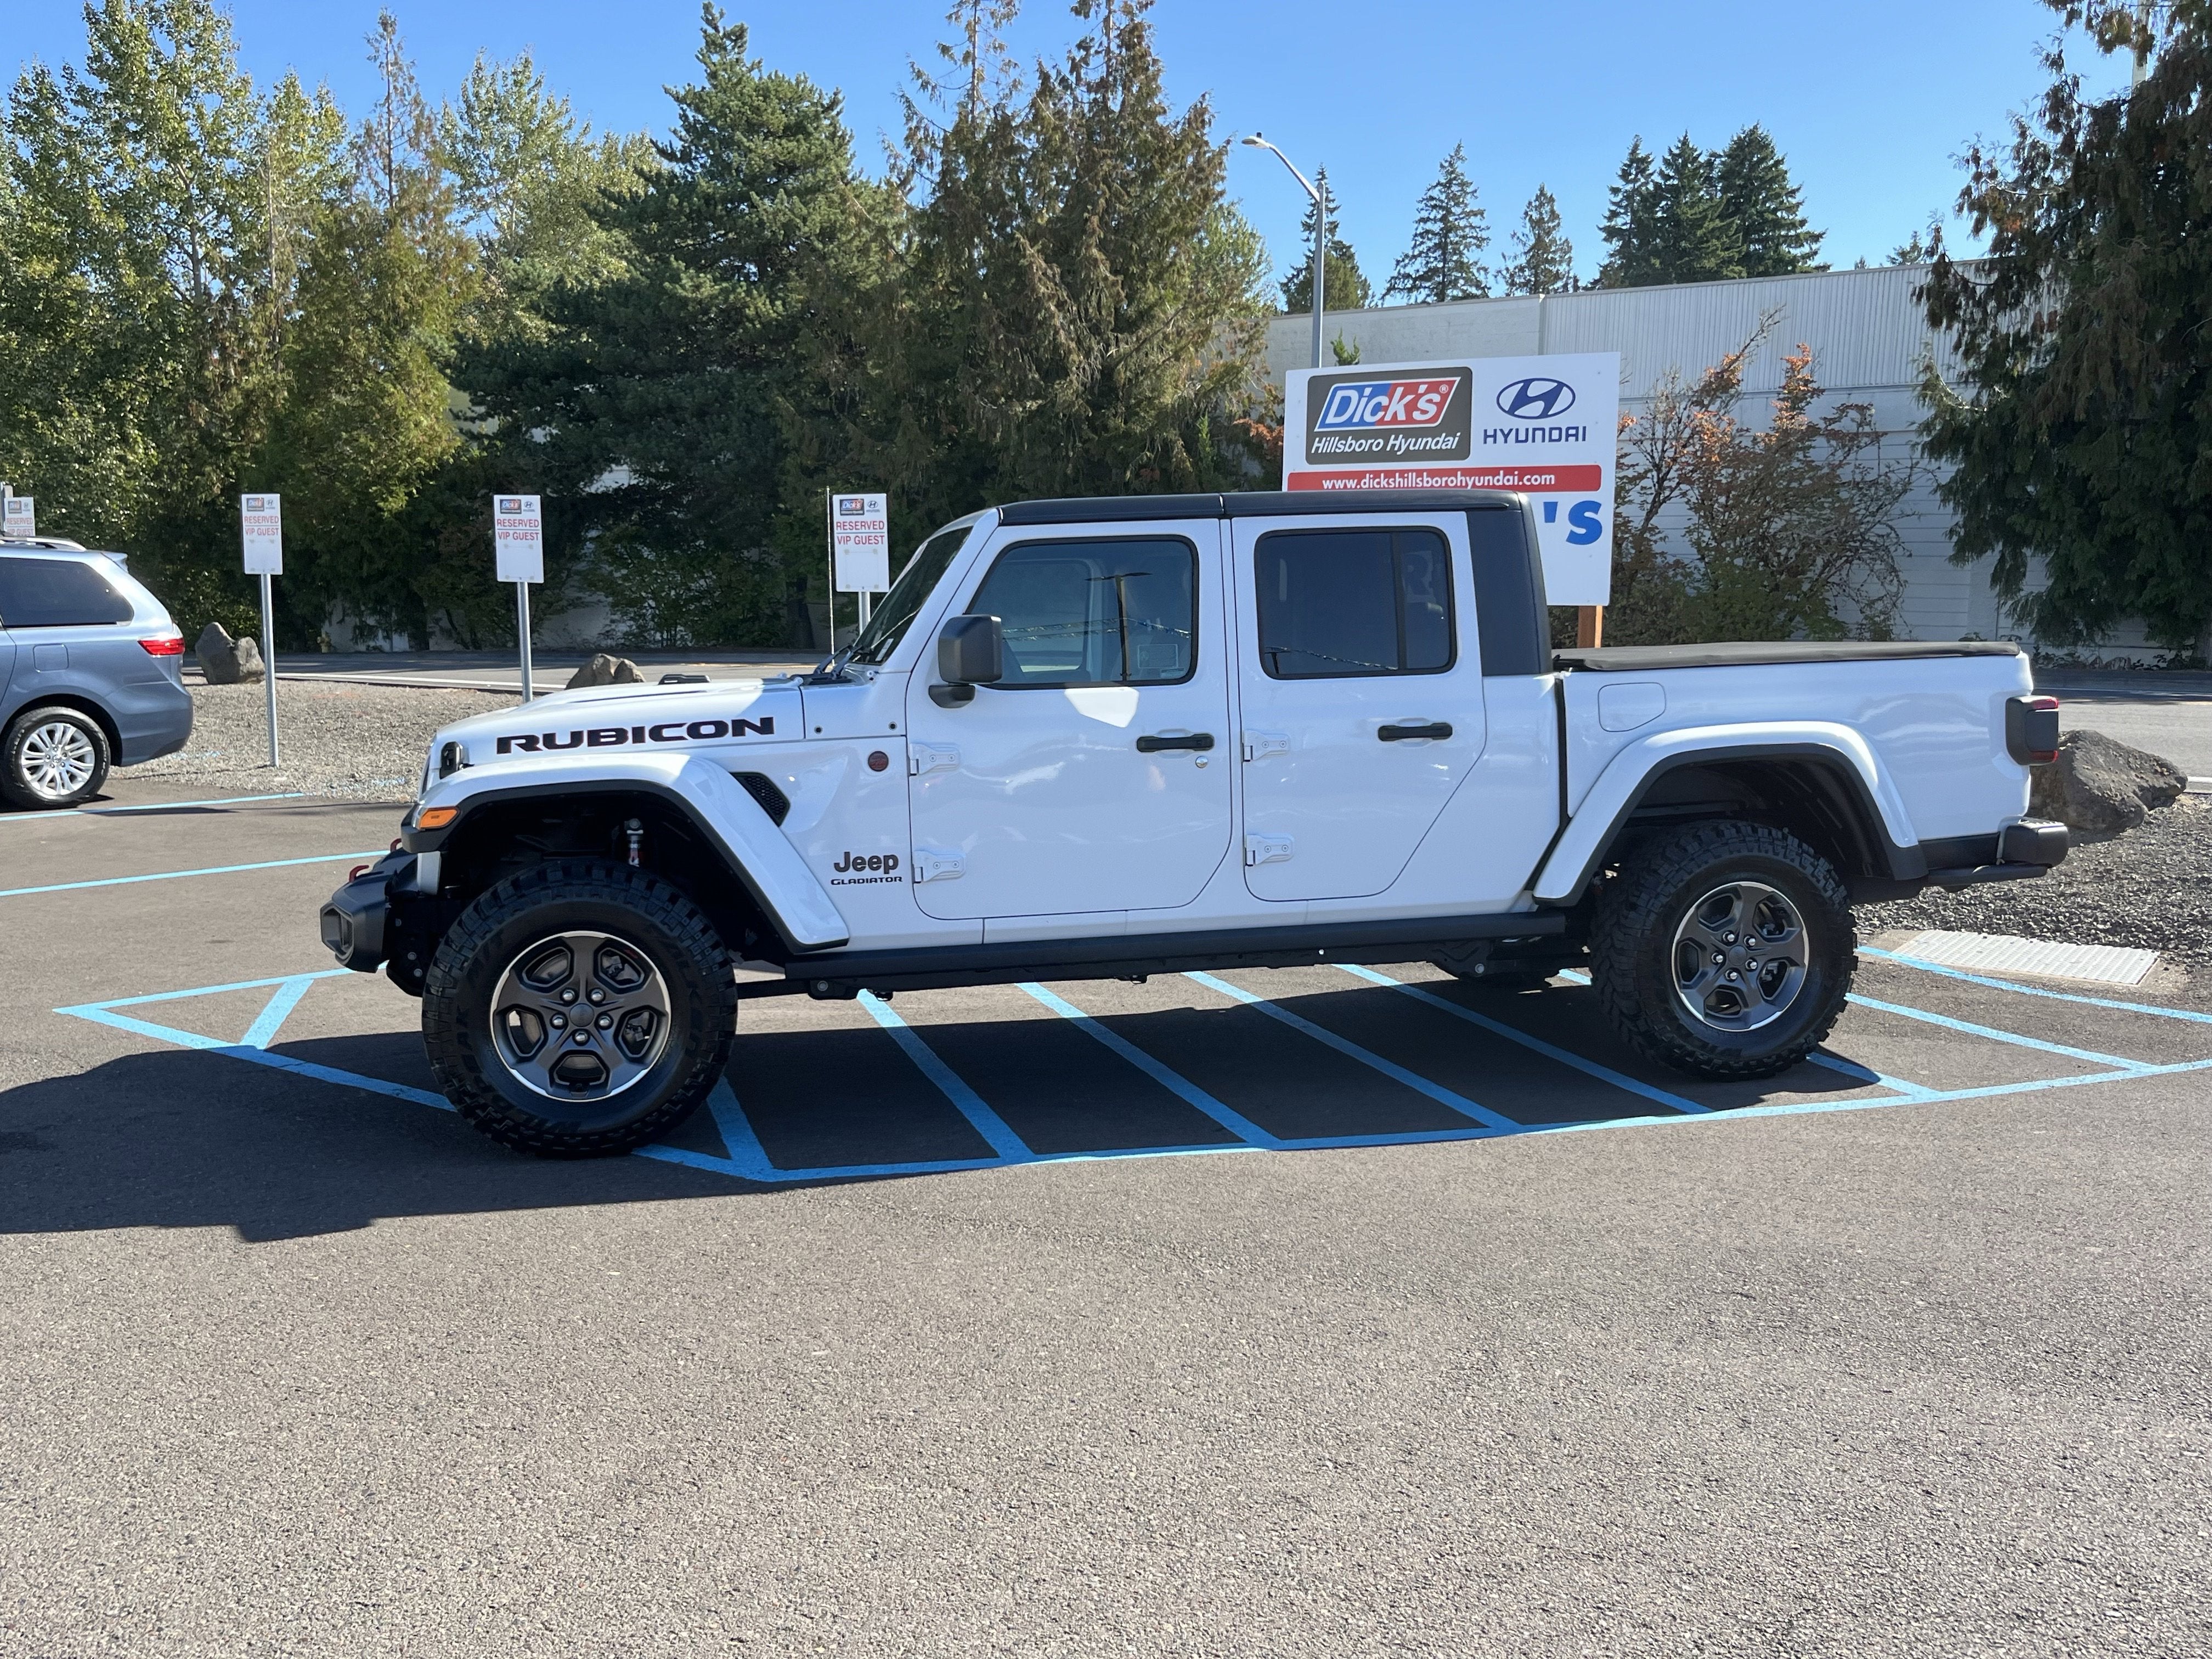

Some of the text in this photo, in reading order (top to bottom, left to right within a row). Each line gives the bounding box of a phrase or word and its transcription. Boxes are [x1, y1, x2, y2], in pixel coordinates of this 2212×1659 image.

[1325, 385, 1441, 424] Dick's
[1483, 426, 1587, 444] HYUNDAI
[1311, 432, 1461, 455] Hillsboro Hyundai
[1322, 471, 1555, 489] www.dickshillsborohyundai.com
[244, 515, 279, 524] RESERVED
[496, 518, 539, 528] RESERVED
[836, 521, 884, 531] RESERVED
[1543, 500, 1602, 545] 'S
[245, 528, 279, 536] VIP GUEST
[498, 531, 539, 541] VIP GUEST
[837, 535, 884, 545] VIP GUEST
[496, 716, 774, 754] RUBICON
[834, 851, 899, 874] Jeep
[831, 876, 902, 885] GLADIATOR
